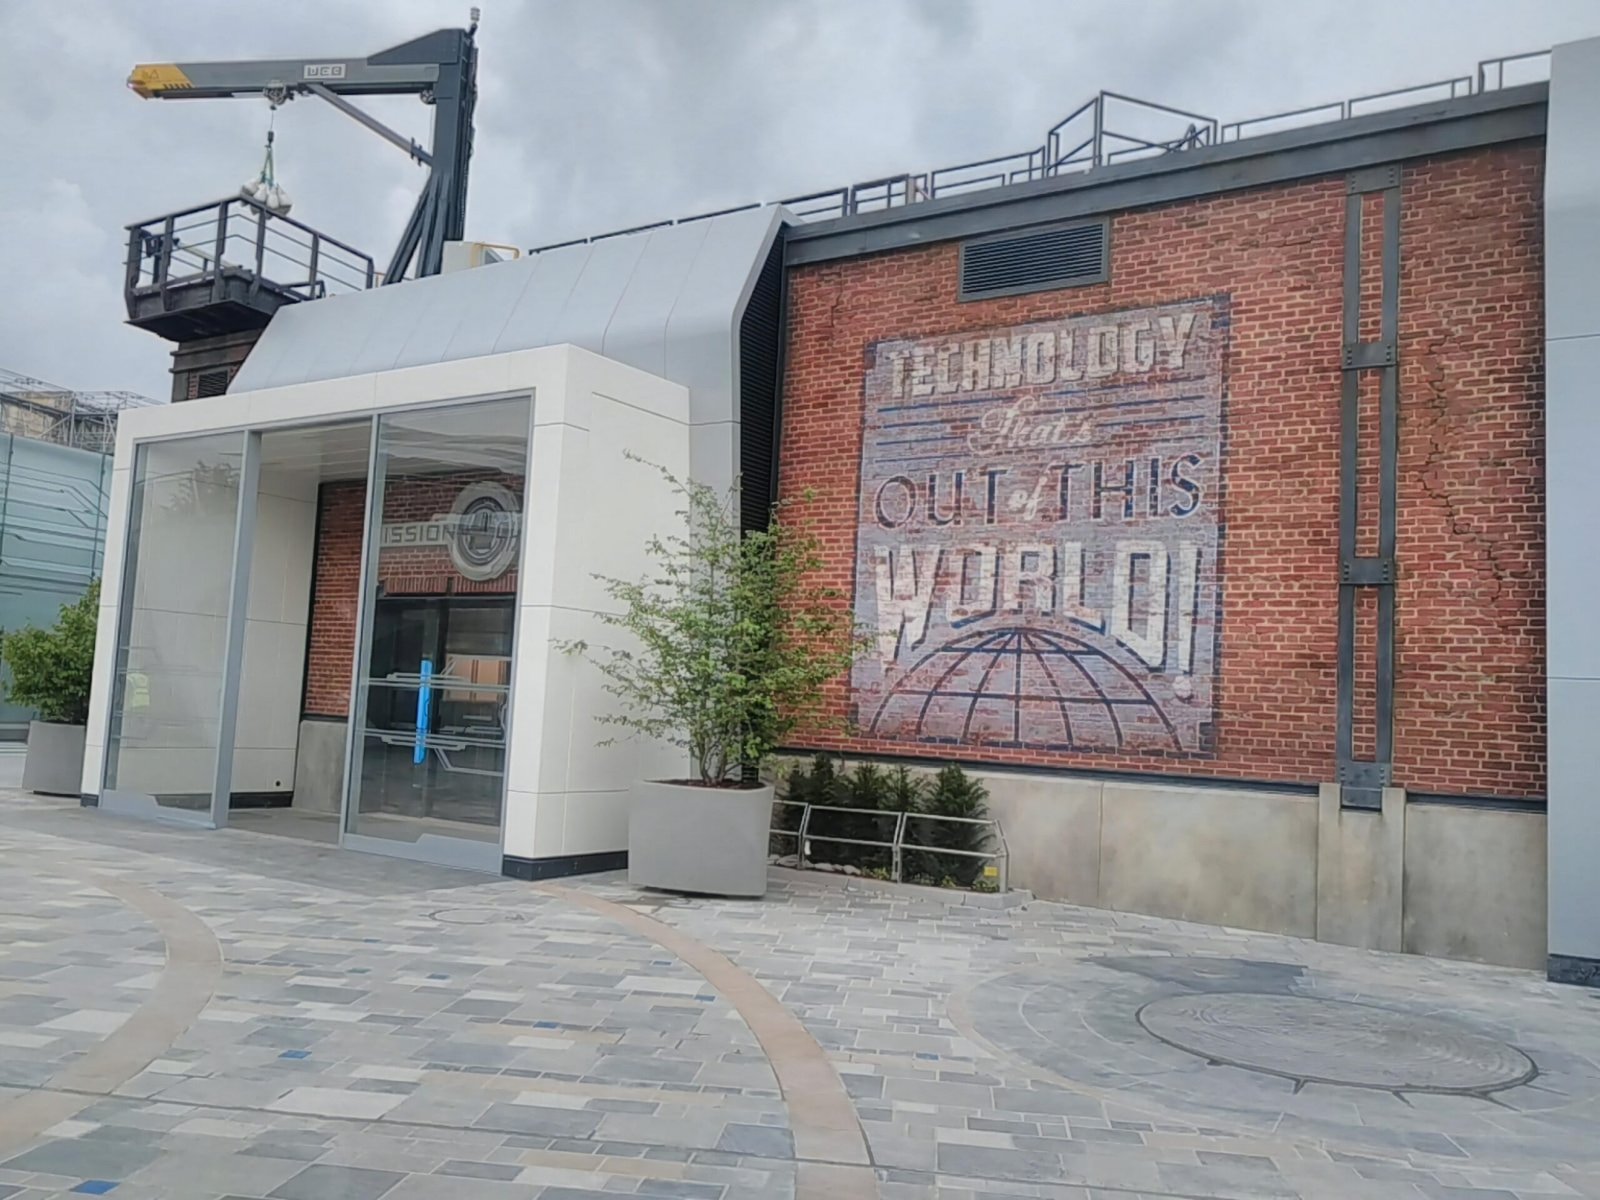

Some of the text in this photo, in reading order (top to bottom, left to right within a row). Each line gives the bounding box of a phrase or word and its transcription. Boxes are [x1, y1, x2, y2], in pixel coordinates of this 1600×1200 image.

[887, 313, 1196, 397] TECHNOLOGY
[874, 453, 1204, 529] OUT of THIS
[381, 523, 455, 544] ISSION
